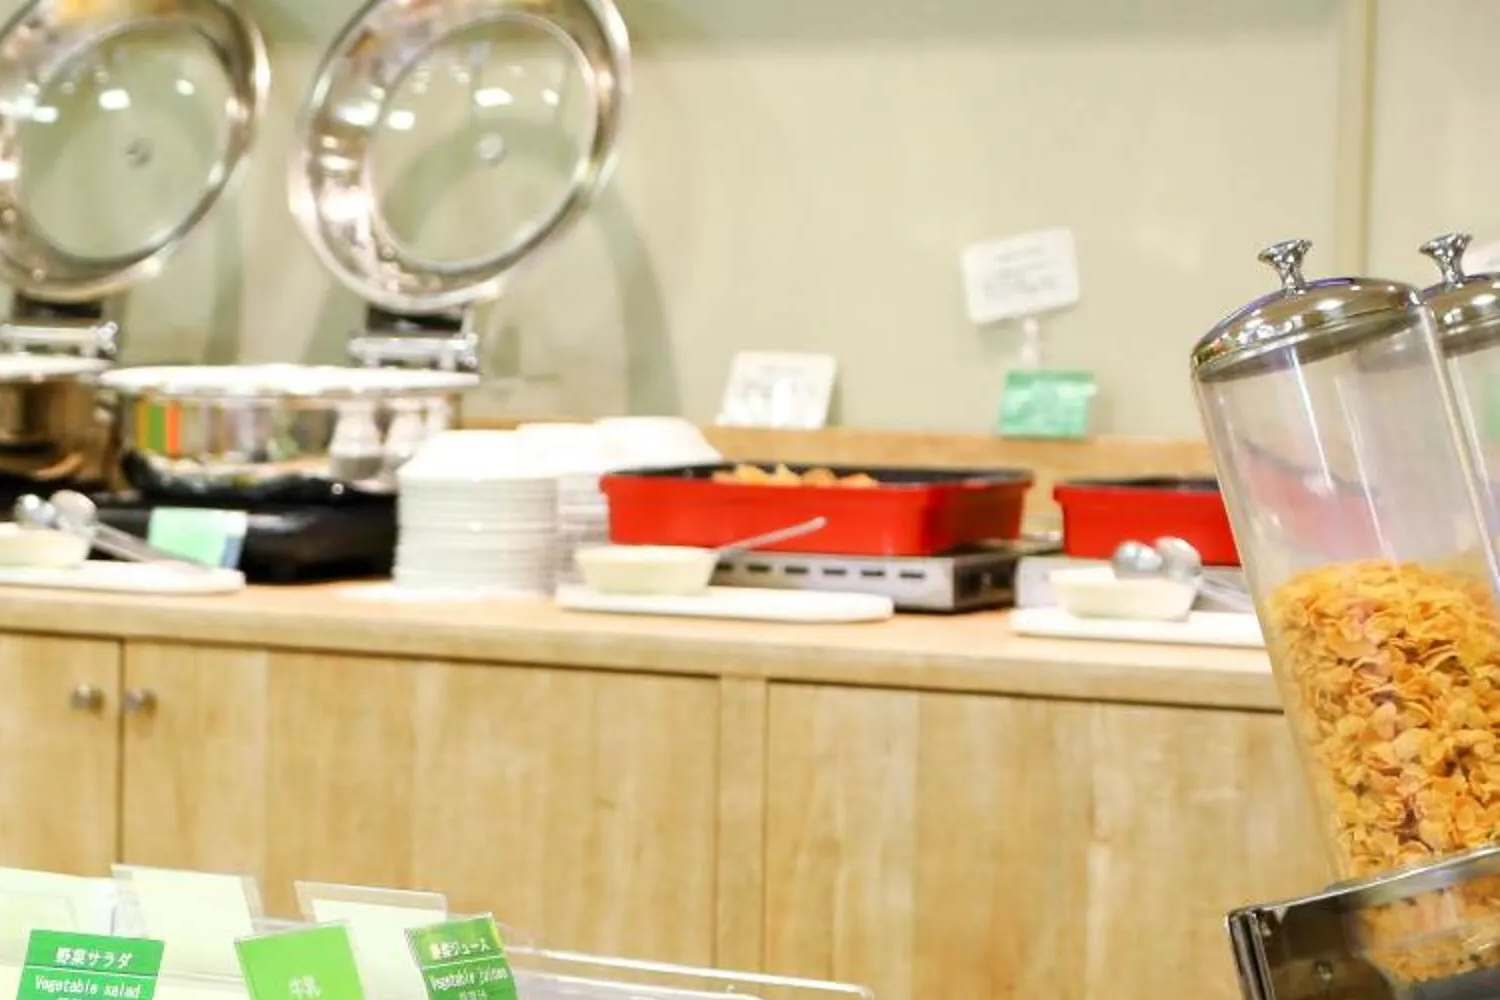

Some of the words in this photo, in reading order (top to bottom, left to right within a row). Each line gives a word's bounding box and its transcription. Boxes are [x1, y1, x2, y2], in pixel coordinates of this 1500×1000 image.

[54, 946, 133, 969] 野菜サラダ
[35, 975, 98, 995] Vegetable
[104, 982, 141, 1000] salad
